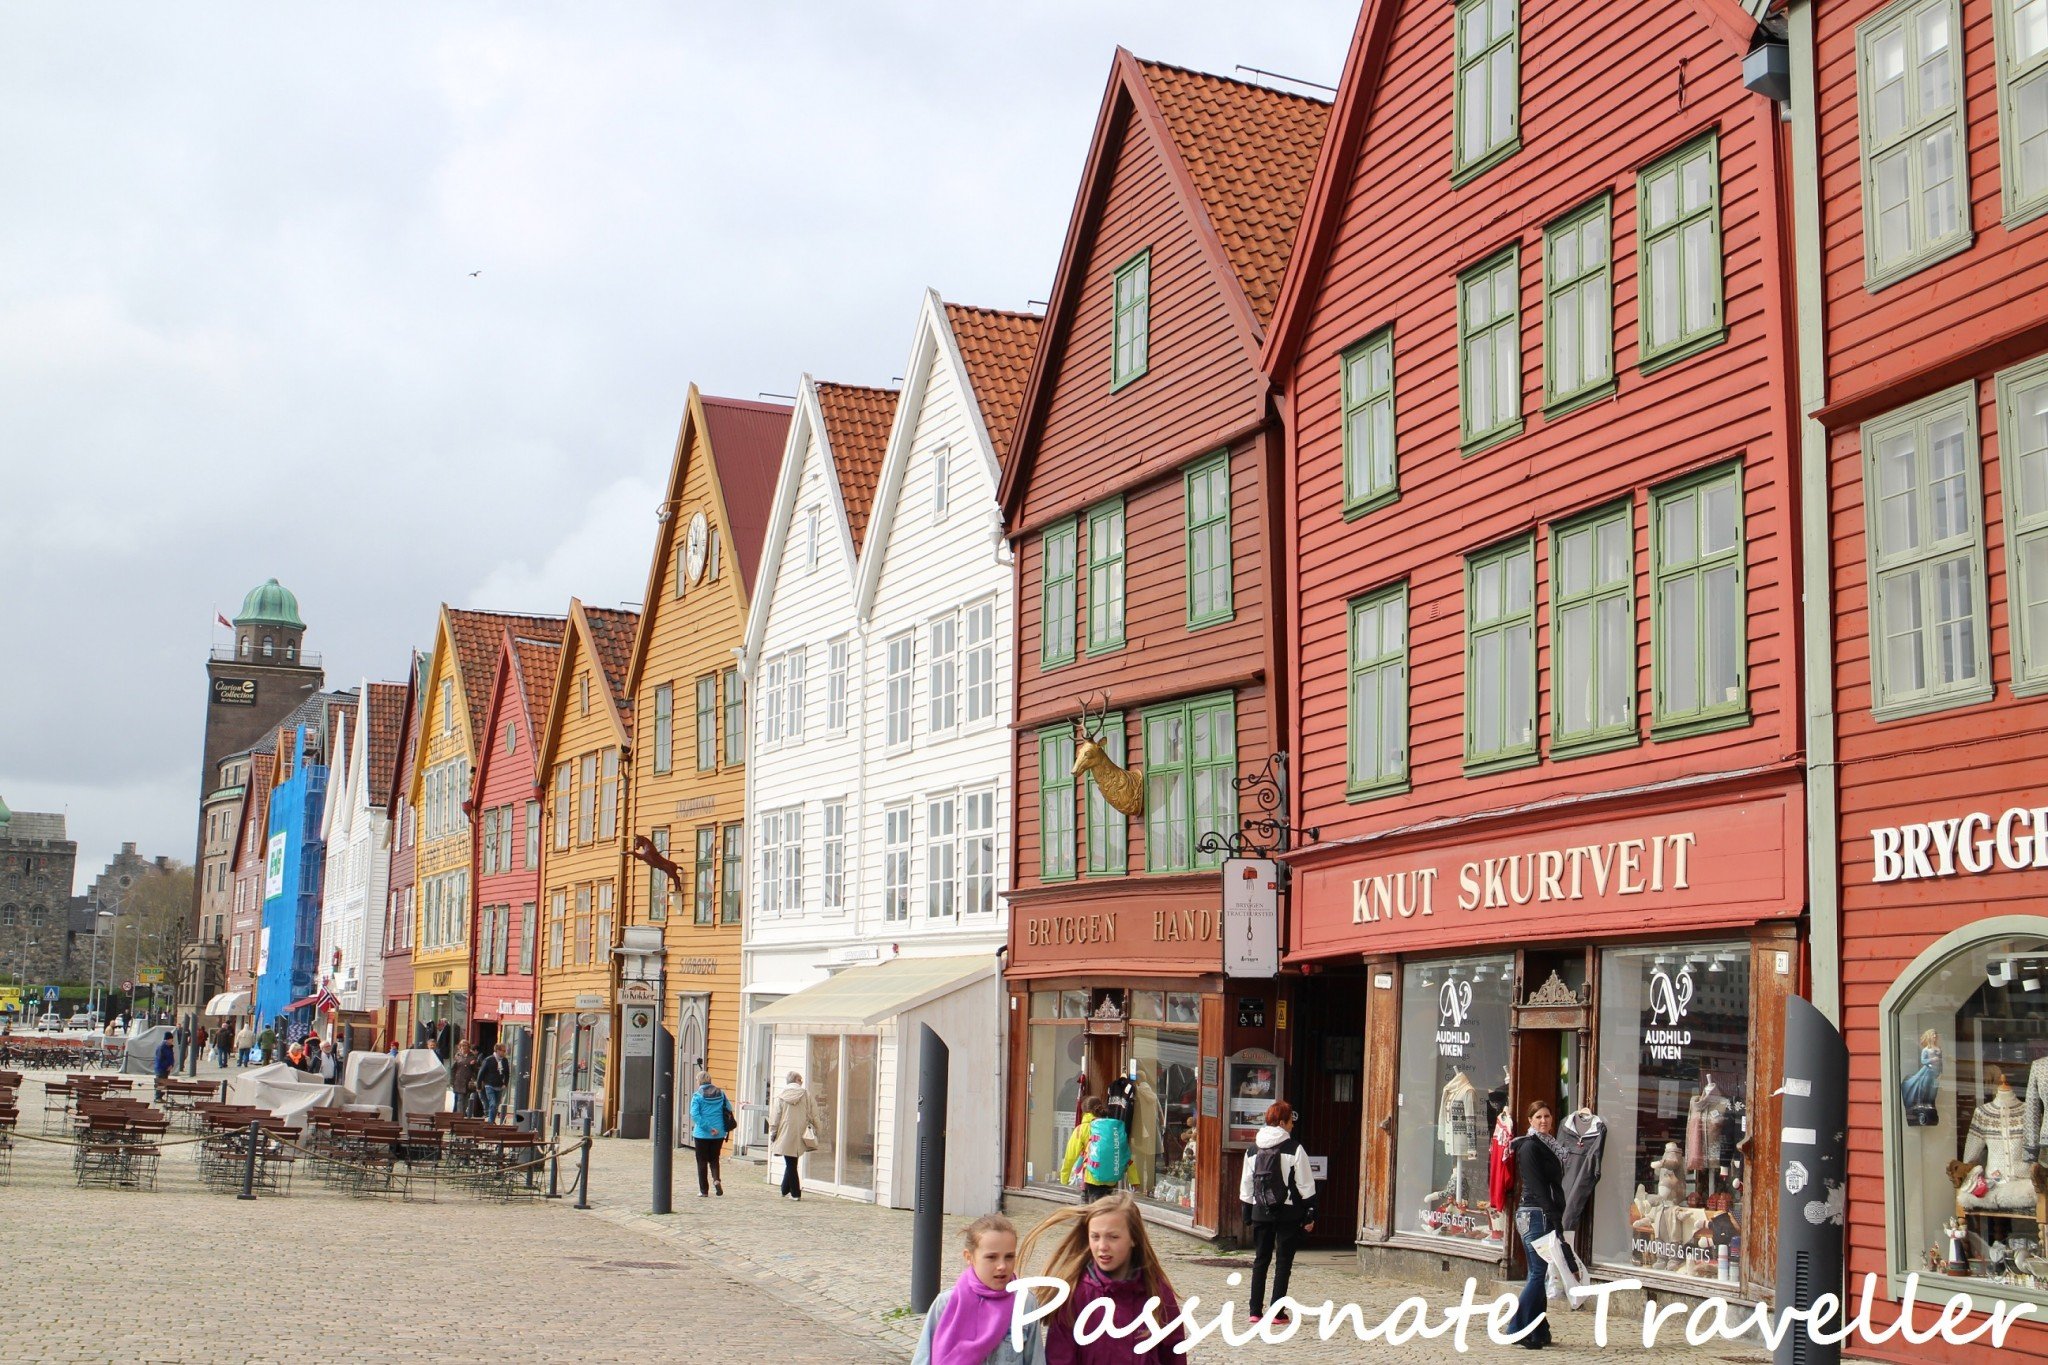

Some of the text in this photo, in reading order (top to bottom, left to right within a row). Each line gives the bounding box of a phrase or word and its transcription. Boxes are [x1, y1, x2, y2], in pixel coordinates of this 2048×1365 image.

[215, 681, 242, 691] Clarion
[221, 691, 254, 699] Collection
[1352, 832, 1696, 925] KNUT SKURTVEIT
[1028, 912, 1117, 946] BRYGGEN
[622, 990, 655, 1000] To Kokker
[1436, 1030, 1470, 1044] AUDHILD
[1645, 1030, 1691, 1045] AUDHILD
[1440, 1044, 1463, 1057] VIKEN
[1650, 1045, 1682, 1060] VIKEN
[1632, 1239, 1710, 1263] MEMORIES & GIFTS
